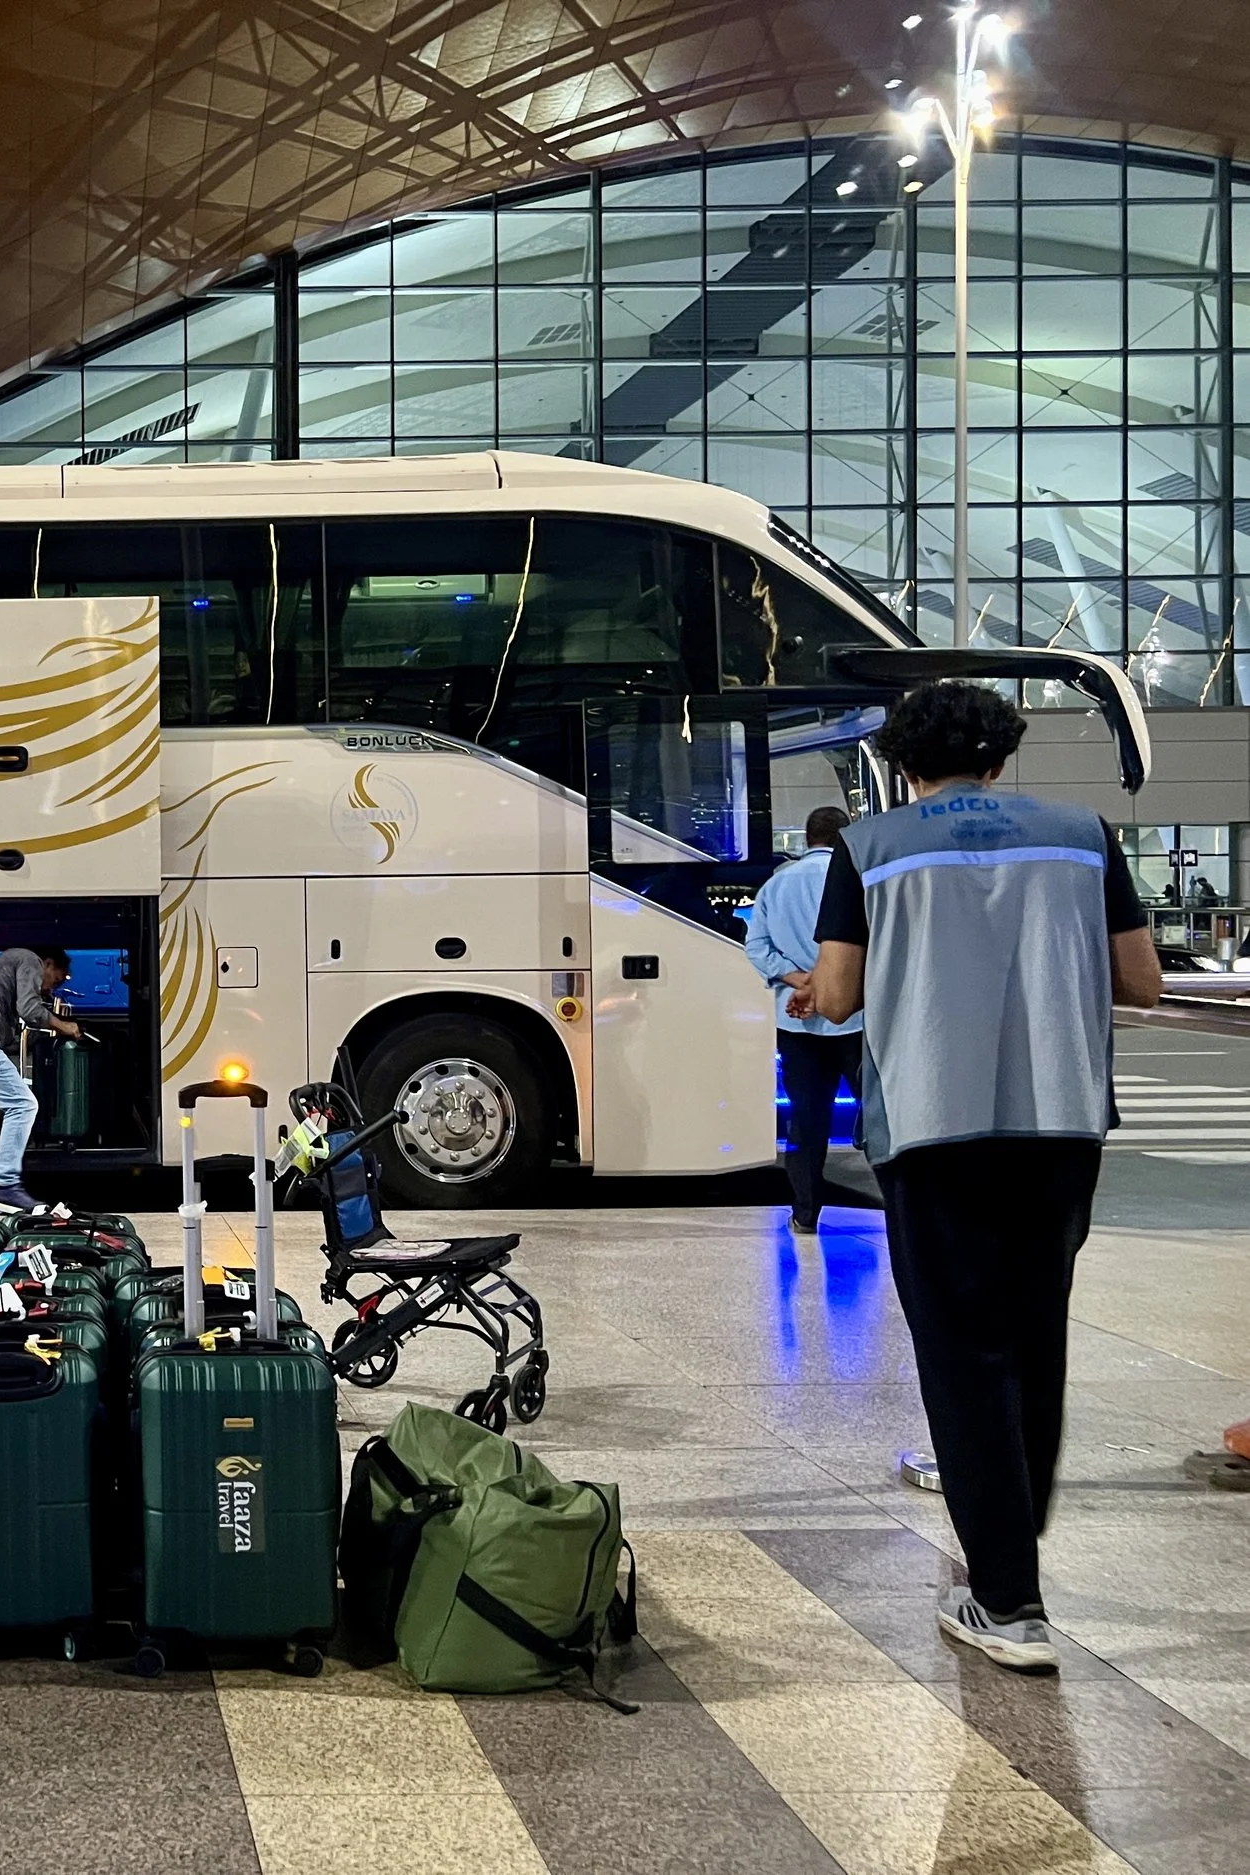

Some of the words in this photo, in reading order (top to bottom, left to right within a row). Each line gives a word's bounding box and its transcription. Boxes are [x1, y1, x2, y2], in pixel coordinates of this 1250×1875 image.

[347, 735, 431, 747] BONLUCK
[217, 1481, 234, 1528] travel
[233, 1481, 257, 1553] faaza
